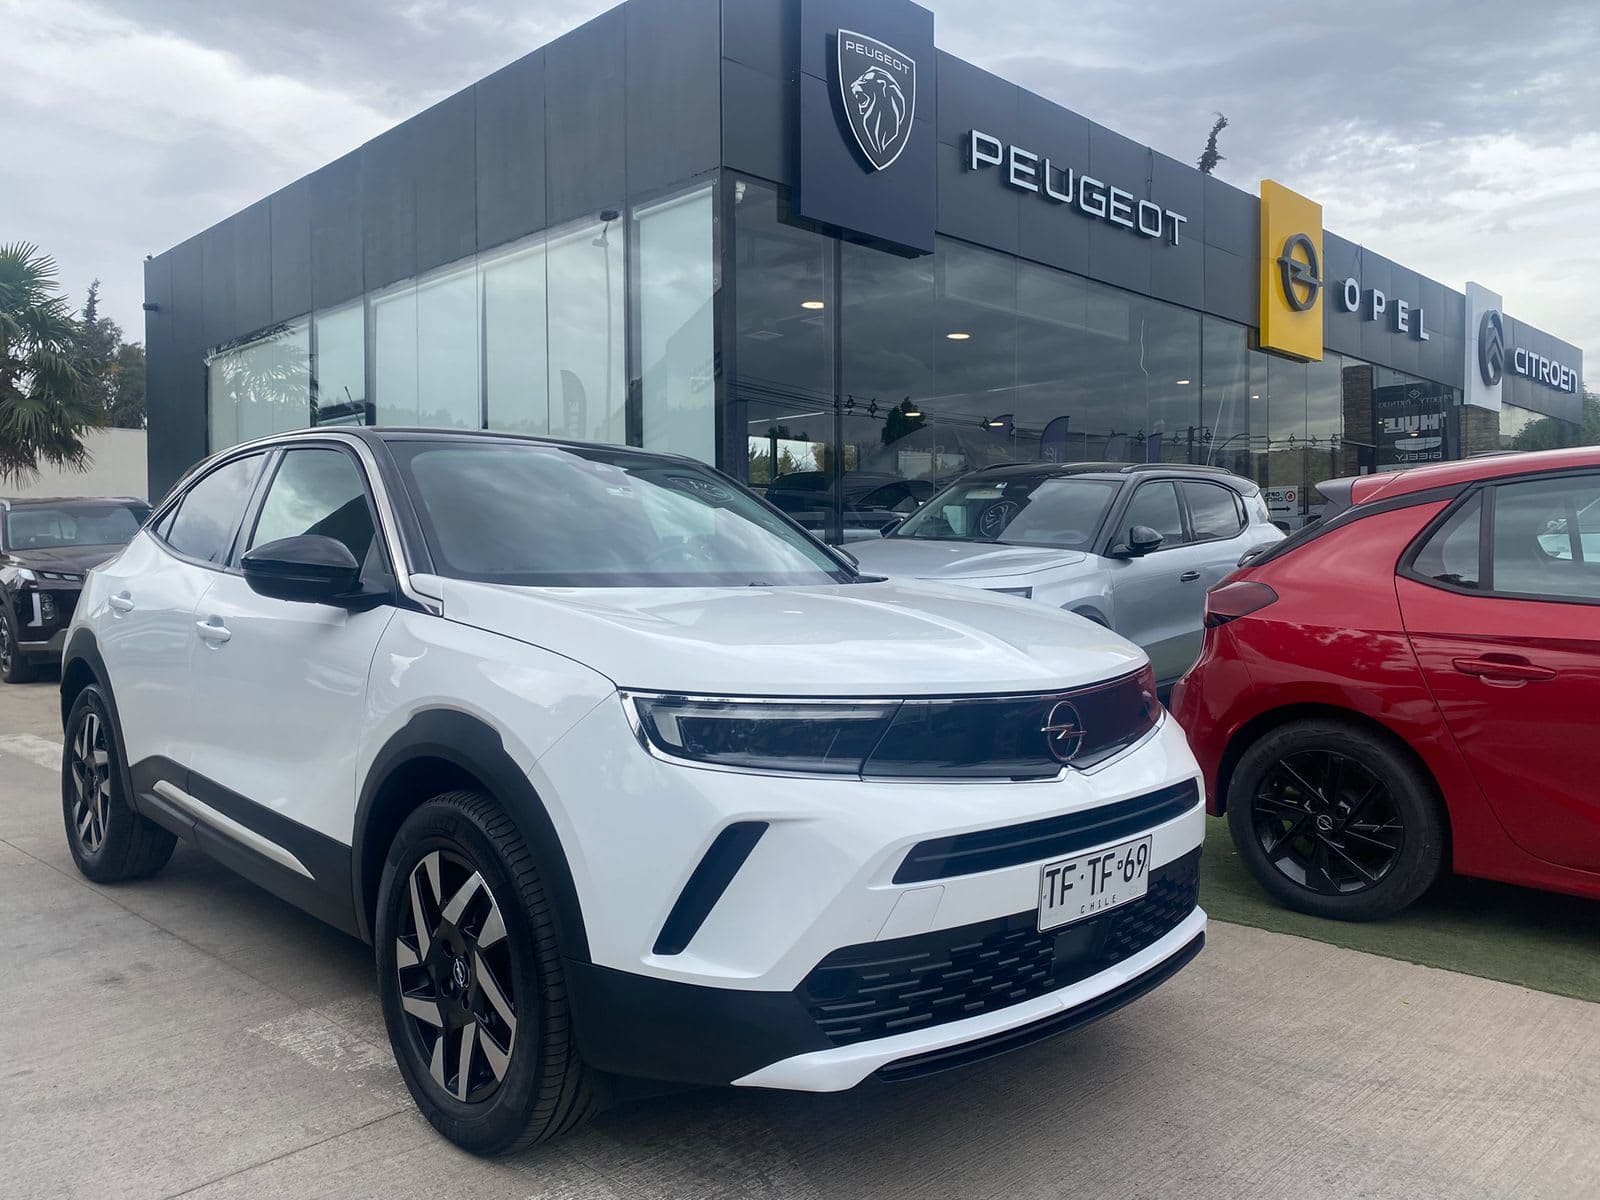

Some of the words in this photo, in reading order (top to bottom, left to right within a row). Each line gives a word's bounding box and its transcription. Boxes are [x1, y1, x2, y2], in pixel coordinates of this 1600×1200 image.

[845, 41, 910, 74] PEUGEOT
[969, 129, 1188, 246] PEUGEOT
[1343, 277, 1430, 341] OPEL
[1080, 894, 1116, 914] CHILE
